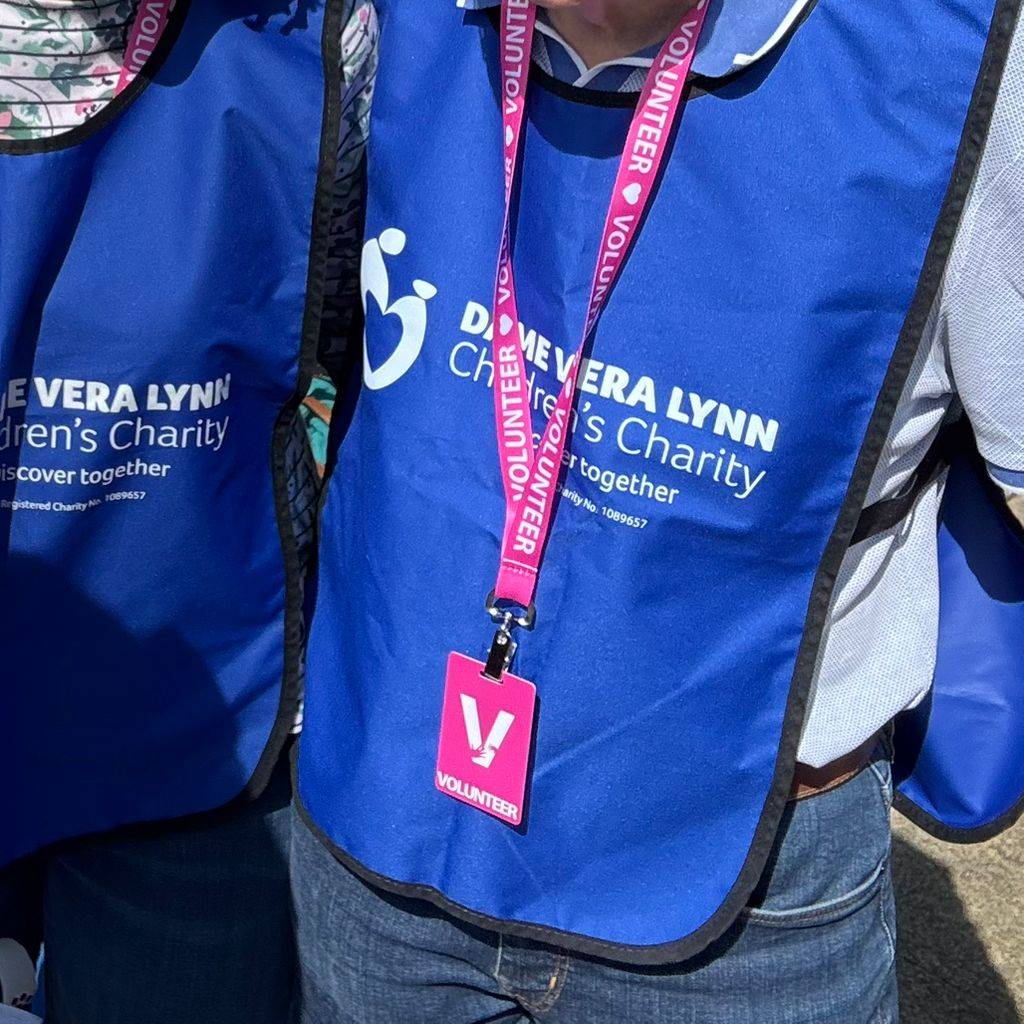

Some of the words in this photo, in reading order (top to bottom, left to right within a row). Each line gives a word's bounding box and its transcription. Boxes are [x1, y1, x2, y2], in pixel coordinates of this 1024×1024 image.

[628, 21, 697, 175] VOLUNTEER
[34, 377, 138, 413] VERA
[147, 373, 231, 411] LYNN
[109, 416, 230, 451] Charity
[666, 386, 779, 452] LYNN
[80, 458, 171, 486] together
[513, 408, 566, 555] VOLUNTEER
[580, 457, 679, 504] together
[617, 417, 766, 499] Charity
[52, 502, 88, 512] Charity
[601, 506, 648, 529] 1089657
[437, 770, 519, 820] VOLUNTEER
